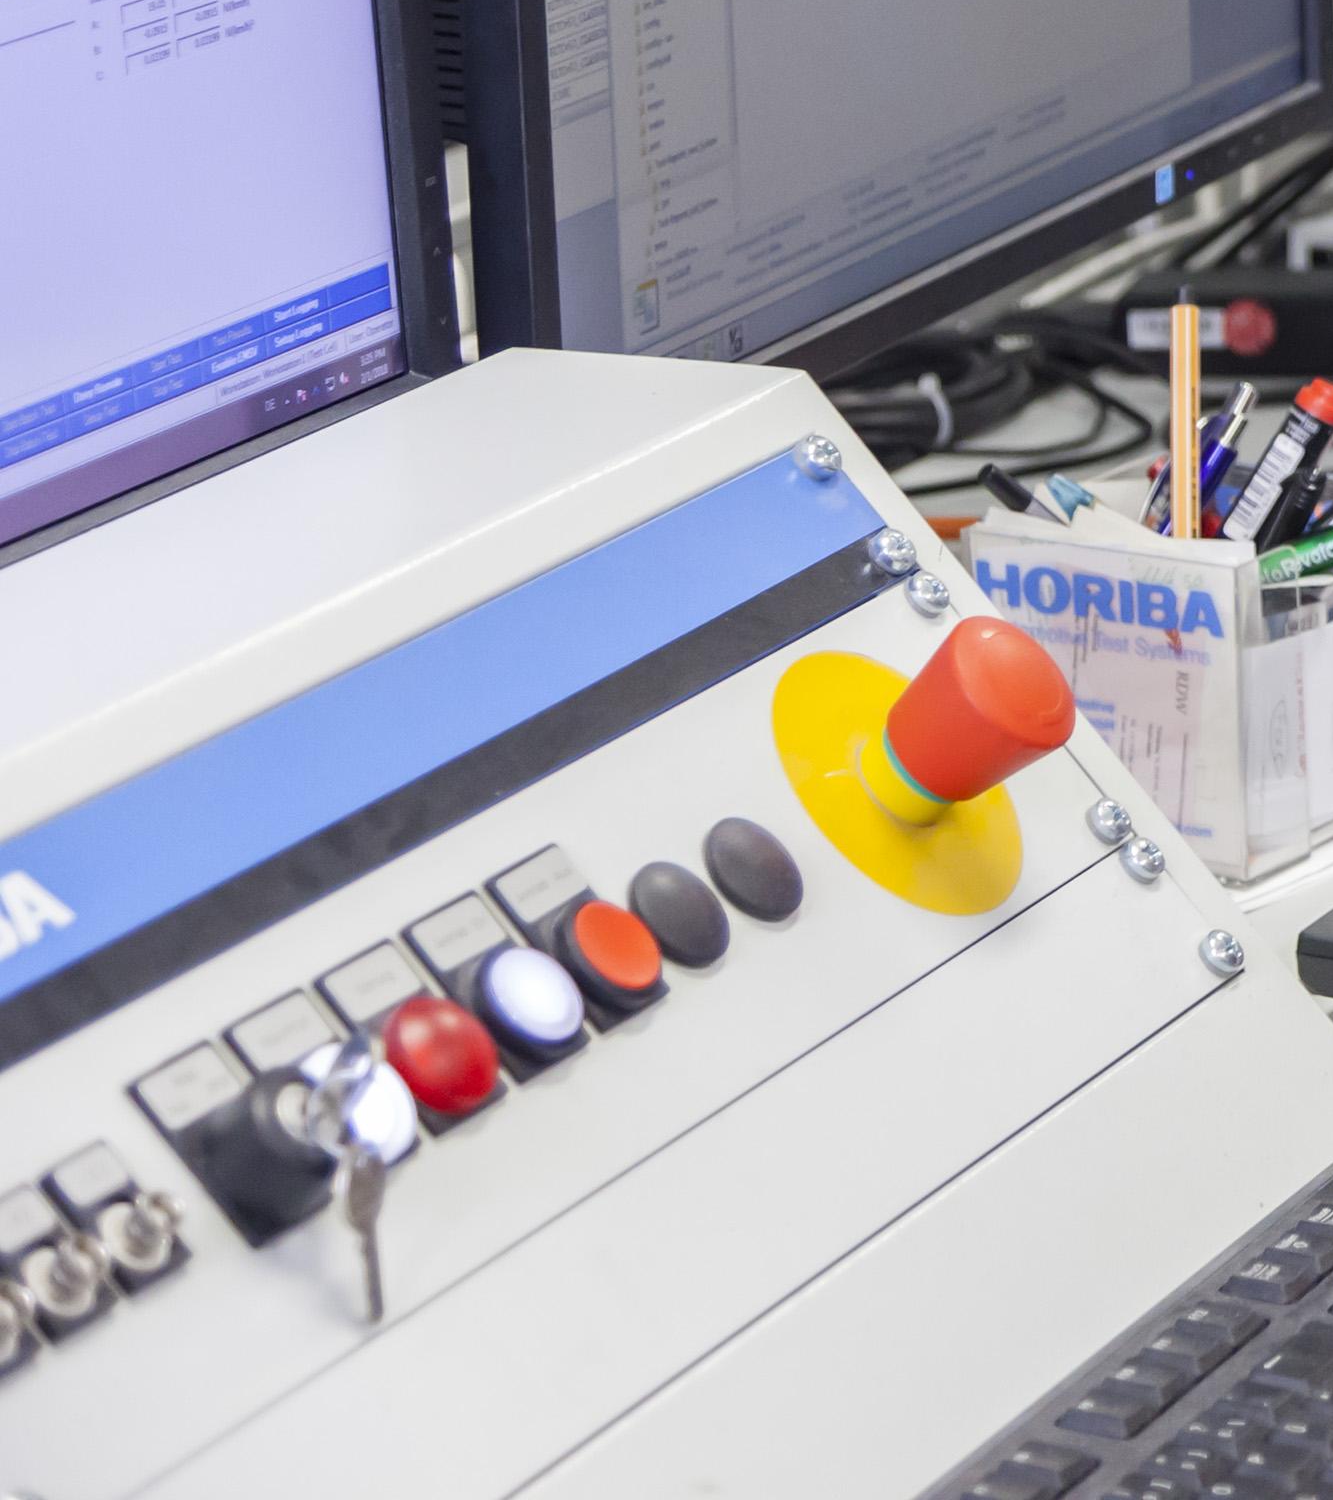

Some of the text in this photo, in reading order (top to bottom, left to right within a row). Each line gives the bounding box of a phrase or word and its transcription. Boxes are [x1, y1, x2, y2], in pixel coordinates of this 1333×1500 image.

[975, 559, 1225, 639] HORIBA
[1096, 626, 1212, 667] Test Systems
